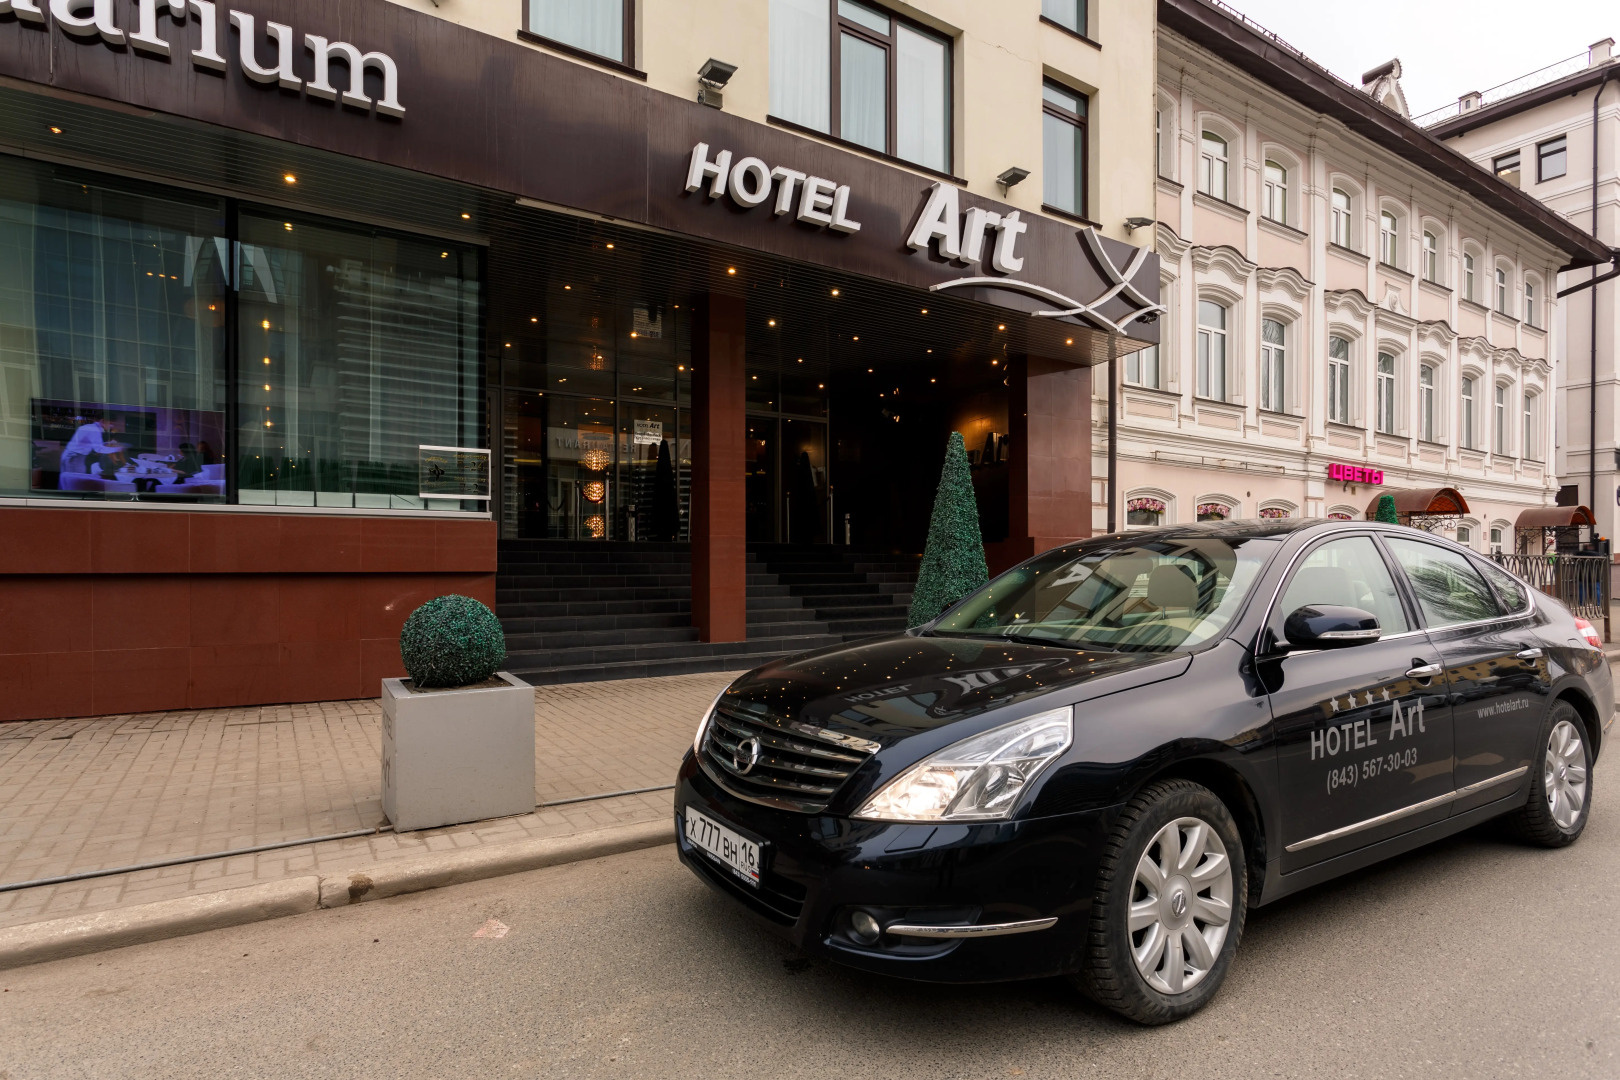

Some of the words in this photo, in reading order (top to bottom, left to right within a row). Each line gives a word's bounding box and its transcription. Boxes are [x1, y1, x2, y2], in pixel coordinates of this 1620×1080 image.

[685, 141, 862, 234] HOTEL
[906, 181, 1027, 275] Art
[1329, 463, 1384, 485] ЦВЕТЫ
[1310, 718, 1377, 760] HOTEL
[1388, 696, 1425, 740] Art
[1477, 698, 1529, 719] www.hotelart.ru
[1326, 763, 1358, 795] (843)
[1362, 747, 1418, 779] 567-30-03
[699, 816, 721, 851] 777
